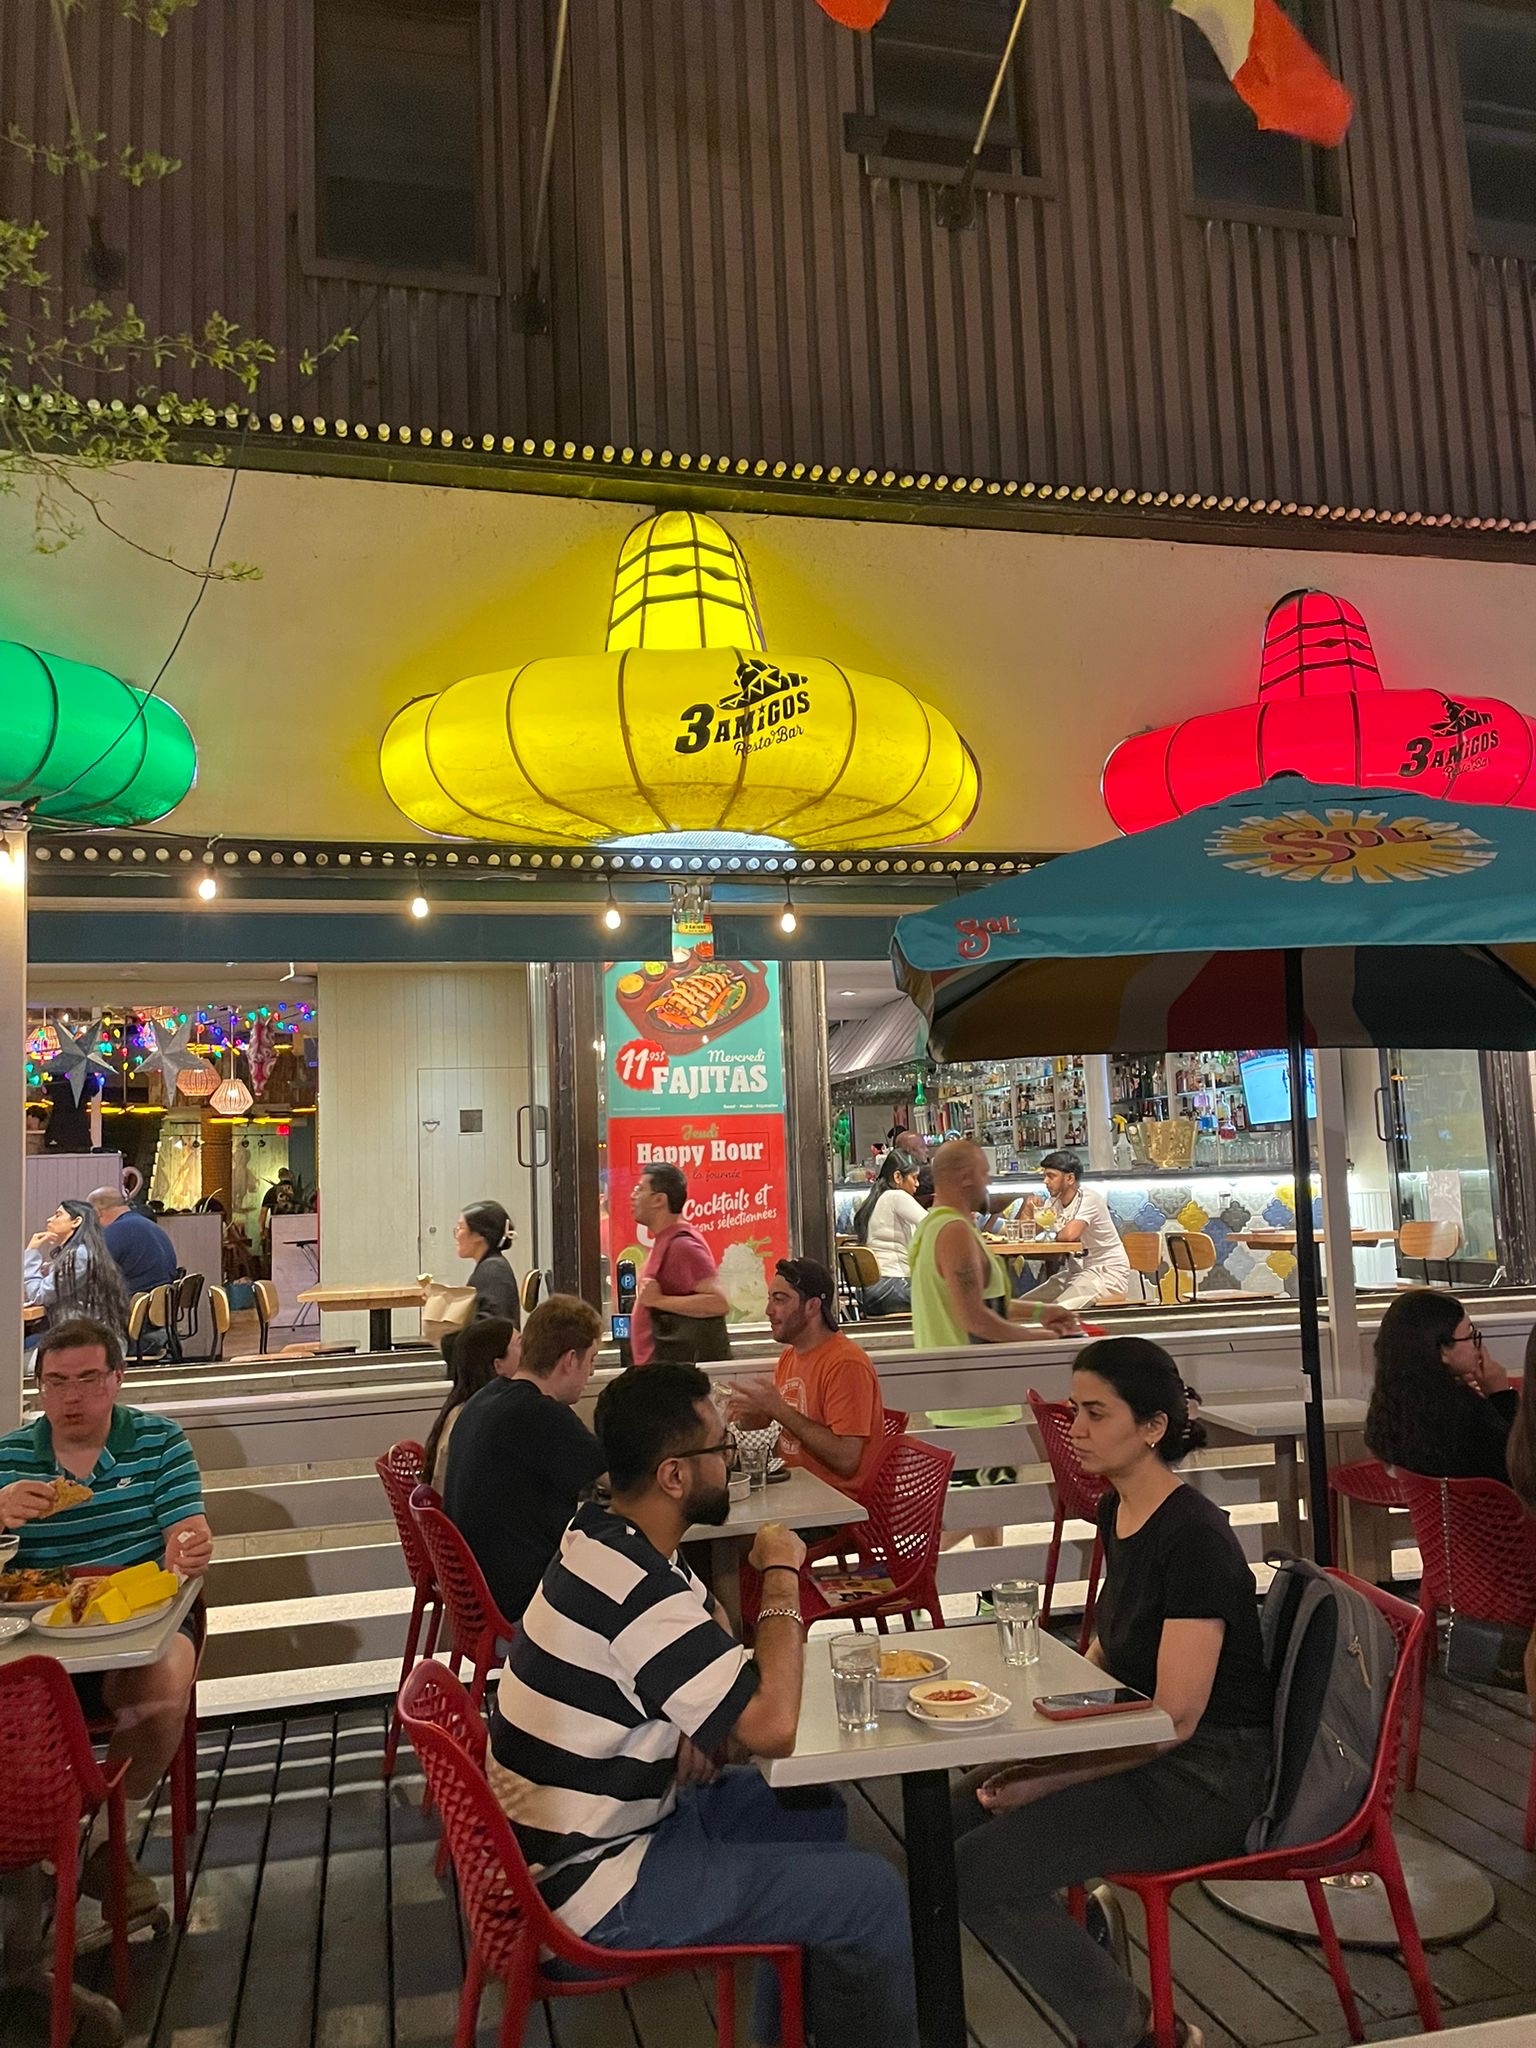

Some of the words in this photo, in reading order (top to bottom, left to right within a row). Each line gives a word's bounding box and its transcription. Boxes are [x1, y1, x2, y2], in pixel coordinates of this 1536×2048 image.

[674, 703, 715, 754] 3
[776, 725, 804, 744] Bar
[1398, 736, 1433, 777] 3
[707, 1047, 767, 1063] Mercredi
[651, 1064, 769, 1100] FAJITAS
[681, 1122, 720, 1141] Jeudi
[636, 1143, 706, 1168] Happy
[710, 1139, 764, 1162] Hour
[681, 1187, 750, 1221] Cocktails
[754, 1183, 774, 1206] et
[717, 1206, 777, 1230] sélectionnées
[623, 1275, 632, 1287] P
[618, 1317, 625, 1328] C
